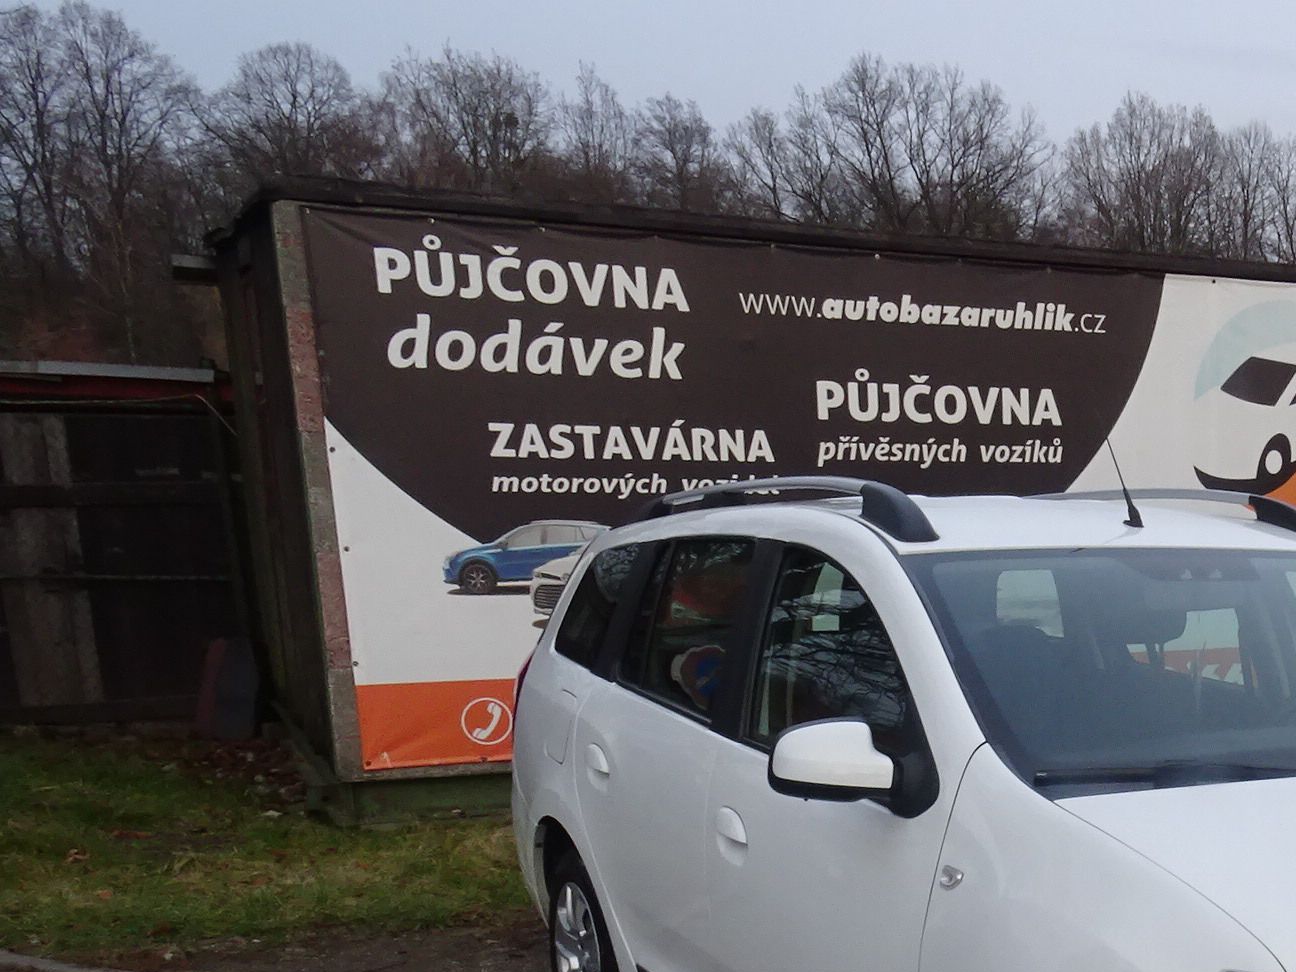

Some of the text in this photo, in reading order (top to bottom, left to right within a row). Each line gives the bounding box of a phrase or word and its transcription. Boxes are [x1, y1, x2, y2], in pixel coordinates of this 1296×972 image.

[373, 234, 690, 312] PŮJČOVNA
[740, 292, 1107, 334] www.autobazaruhlik.cz
[387, 313, 686, 380] dodávek
[816, 368, 1062, 426] PŮJČOVNA
[488, 419, 775, 462] ZASTAVÁRNA
[817, 437, 1064, 469] přívěsných vozíků
[492, 471, 667, 499] motorových
